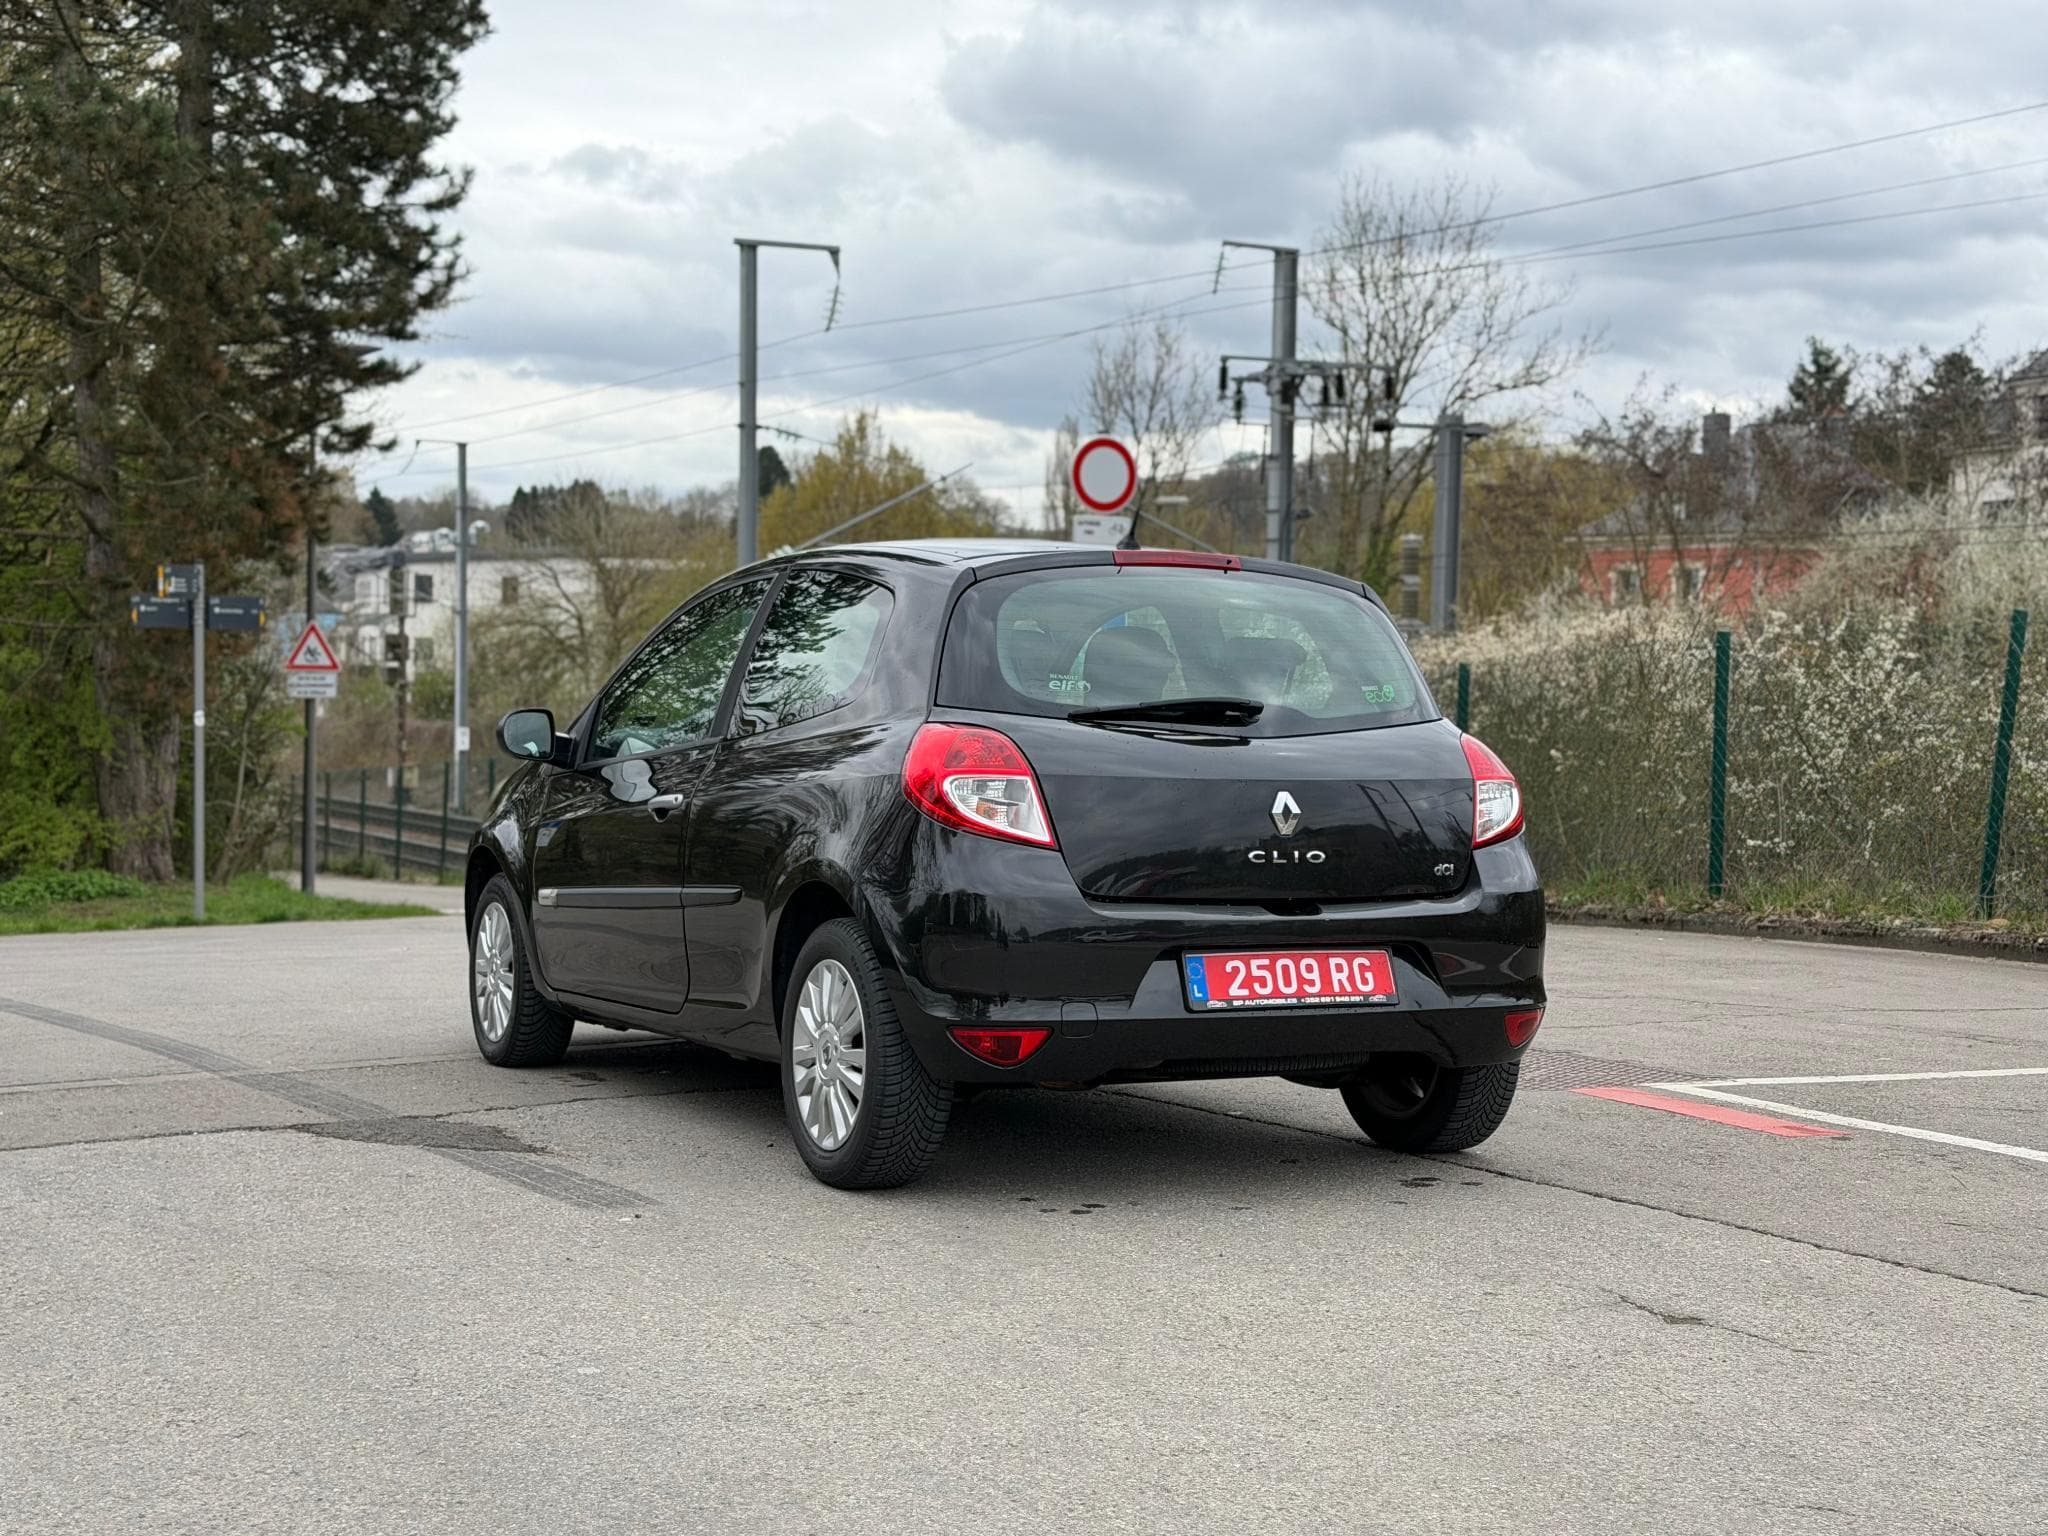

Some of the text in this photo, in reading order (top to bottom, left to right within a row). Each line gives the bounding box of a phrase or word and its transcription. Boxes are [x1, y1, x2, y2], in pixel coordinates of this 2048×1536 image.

[1048, 680, 1076, 691] elf
[1247, 850, 1327, 864] CLIO
[1225, 957, 1375, 997] 2509 RG
[1193, 984, 1203, 997] L
[1244, 998, 1298, 1006] AUTOMOBILES
